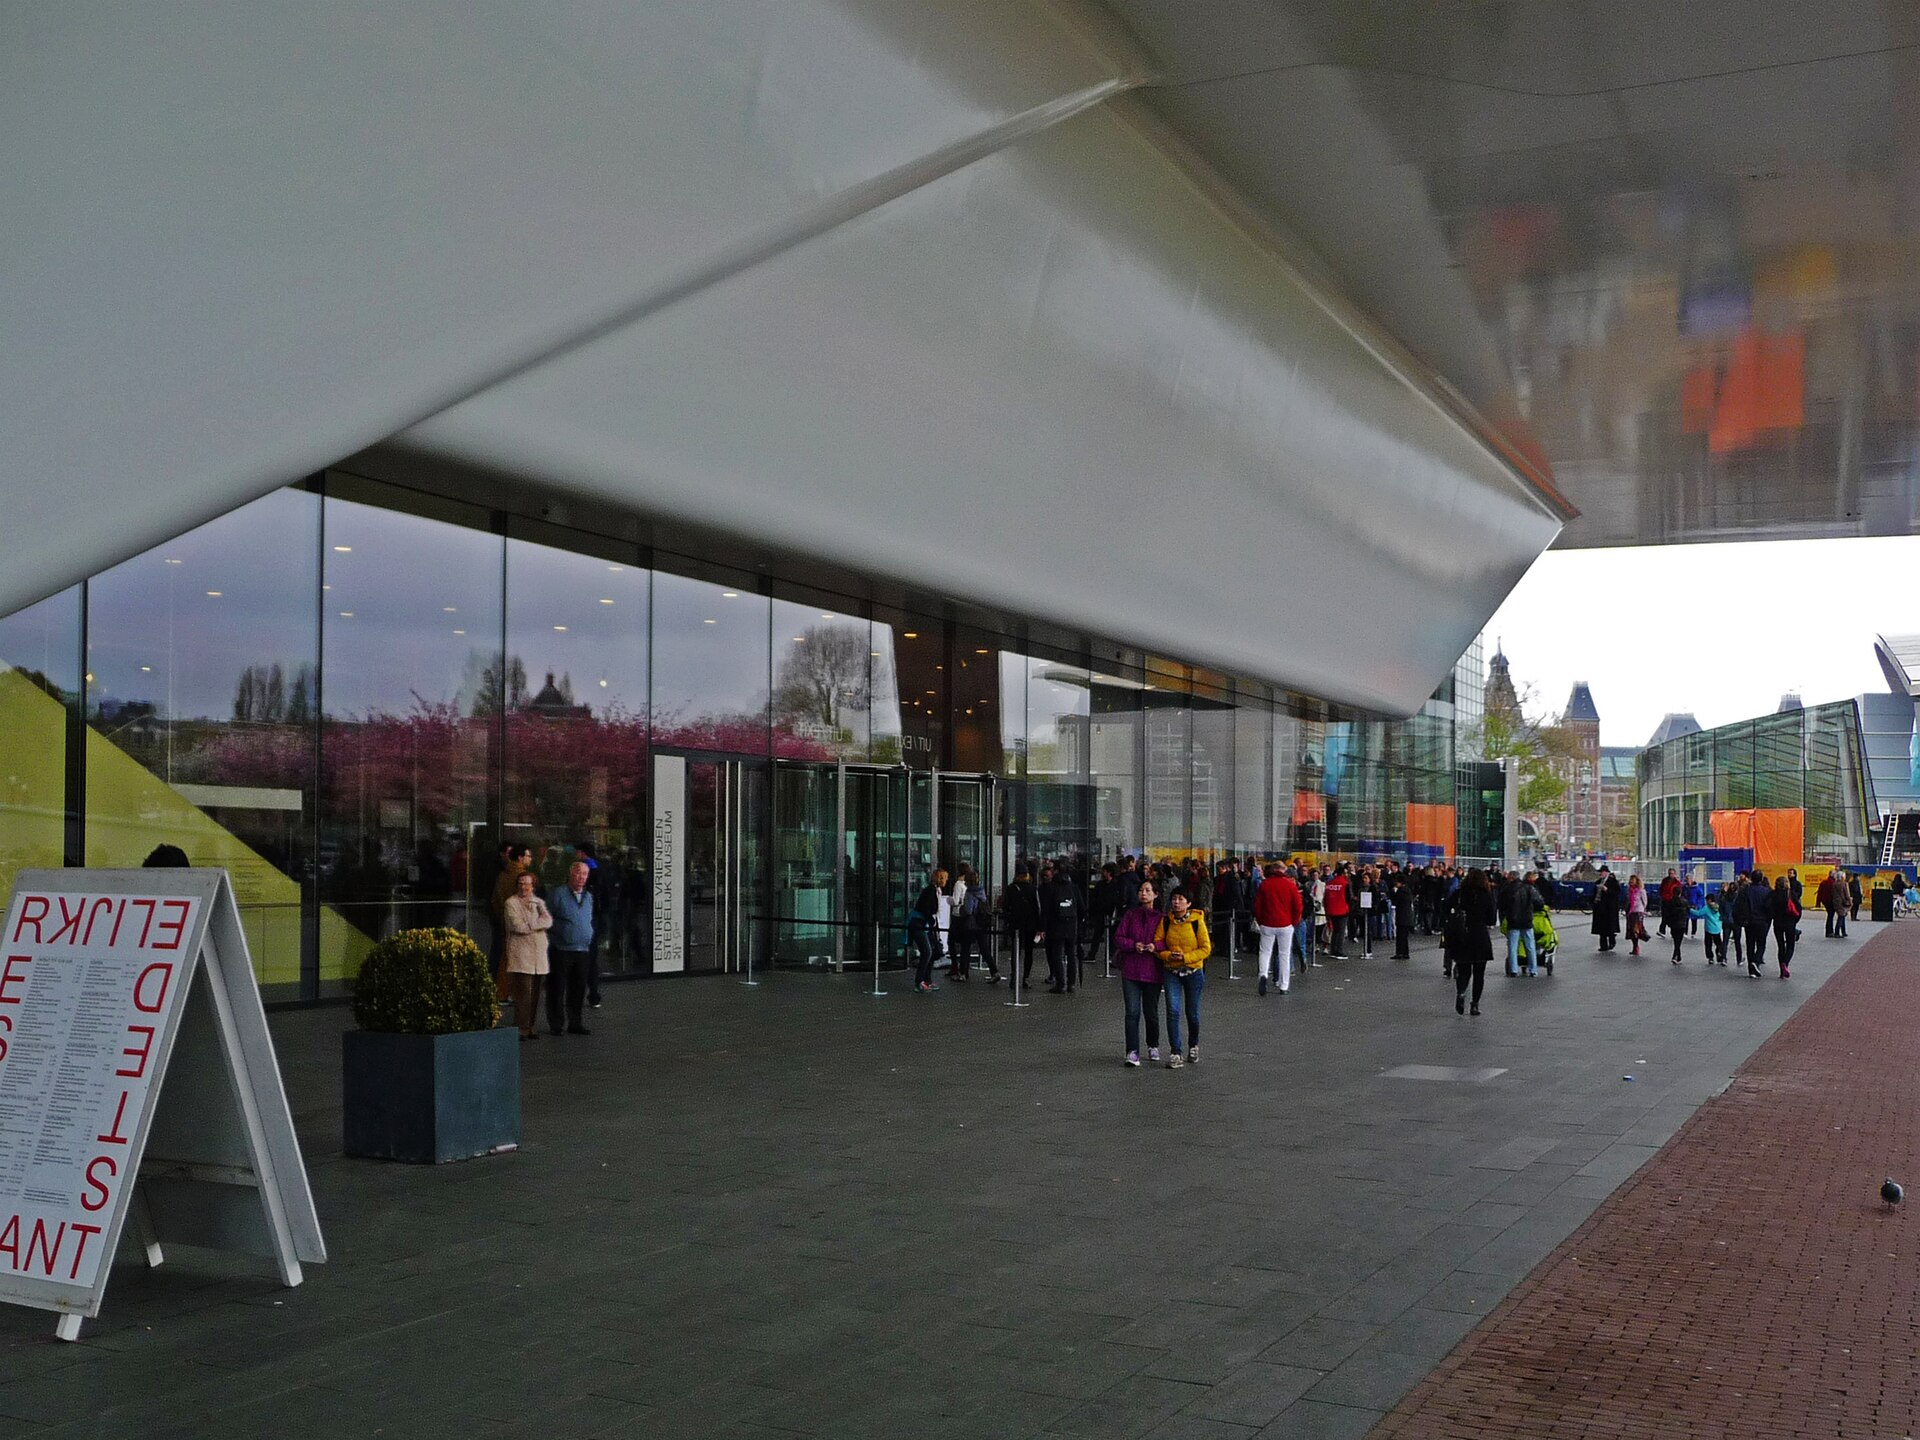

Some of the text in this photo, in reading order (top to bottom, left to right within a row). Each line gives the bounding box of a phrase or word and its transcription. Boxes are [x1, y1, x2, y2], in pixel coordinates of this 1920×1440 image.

[654, 818, 664, 961] ENTREE VRIENDEN
[663, 810, 673, 960] STEDELIJK MUSEUM
